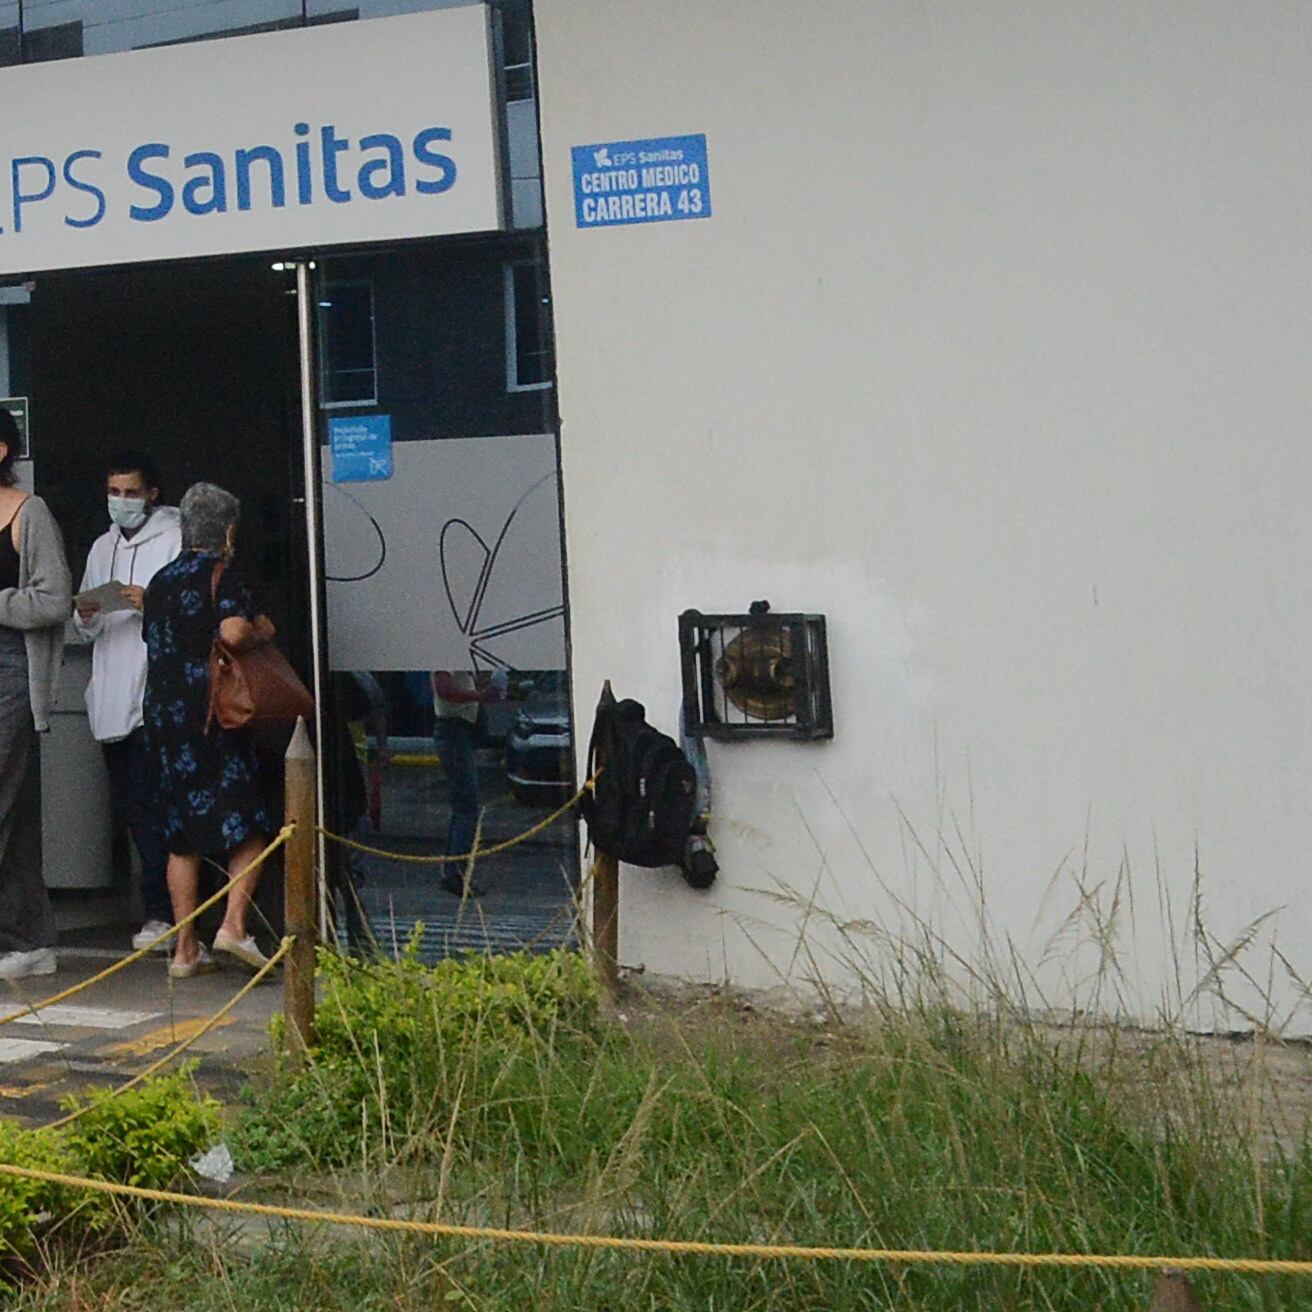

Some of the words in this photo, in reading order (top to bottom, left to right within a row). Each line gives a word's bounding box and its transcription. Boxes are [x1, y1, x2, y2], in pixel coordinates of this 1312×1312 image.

[126, 122, 458, 222] Sanitas
[614, 153, 636, 166] EPS
[639, 150, 684, 163] Sanitas
[582, 170, 638, 193] CENTRO
[641, 163, 700, 188] MEDICO
[583, 192, 673, 222] CARRERA
[677, 188, 703, 214] 43
